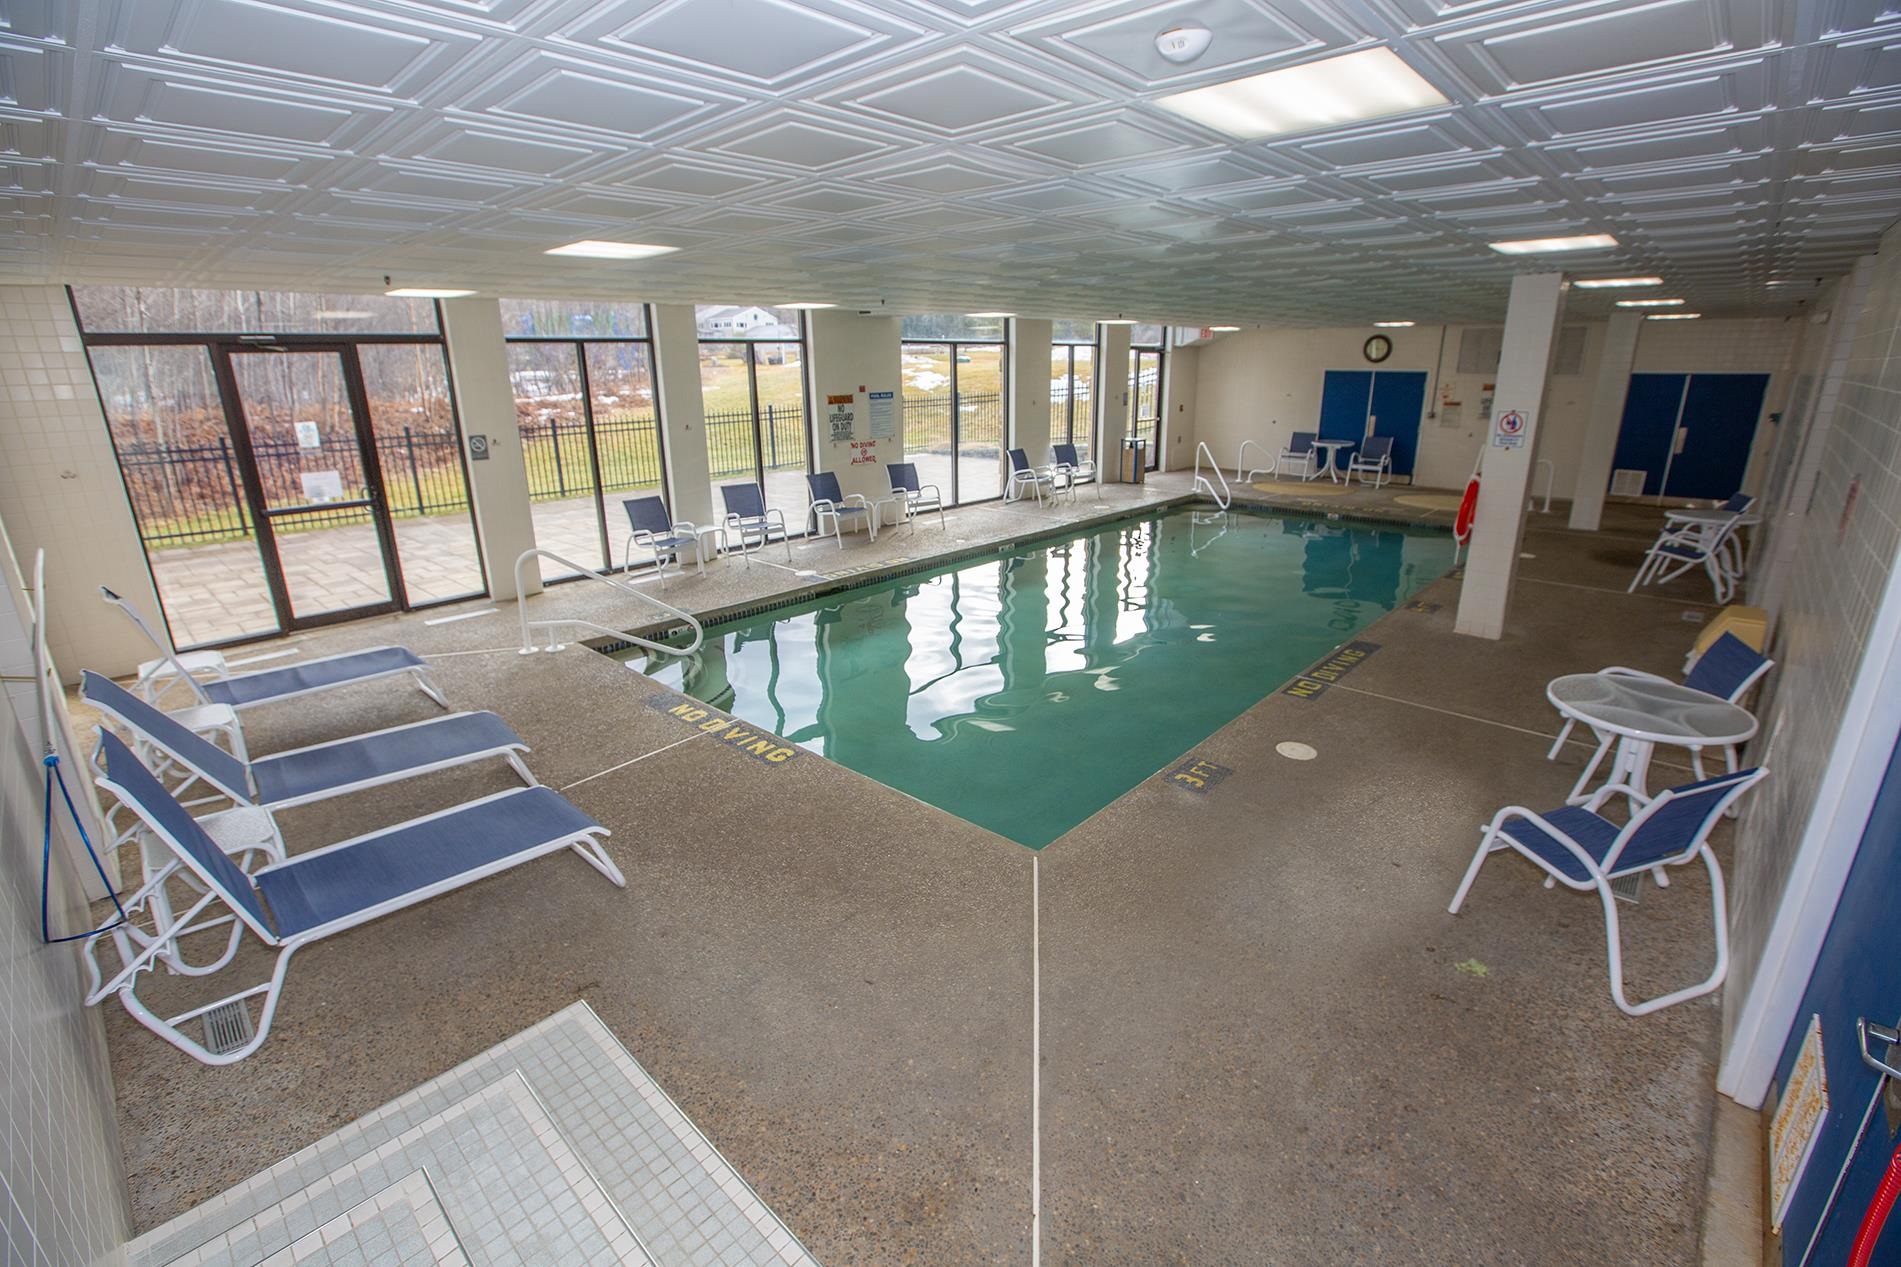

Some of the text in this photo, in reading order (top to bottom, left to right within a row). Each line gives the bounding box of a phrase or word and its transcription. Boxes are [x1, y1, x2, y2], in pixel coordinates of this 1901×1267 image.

[837, 404, 845, 413] NO
[829, 413, 854, 423] LIFEGUARD
[832, 422, 852, 431] ON DUTY
[851, 456, 876, 465] ALLOWED
[1288, 649, 1366, 697] NO DIVING
[668, 703, 795, 762] NO DIVING
